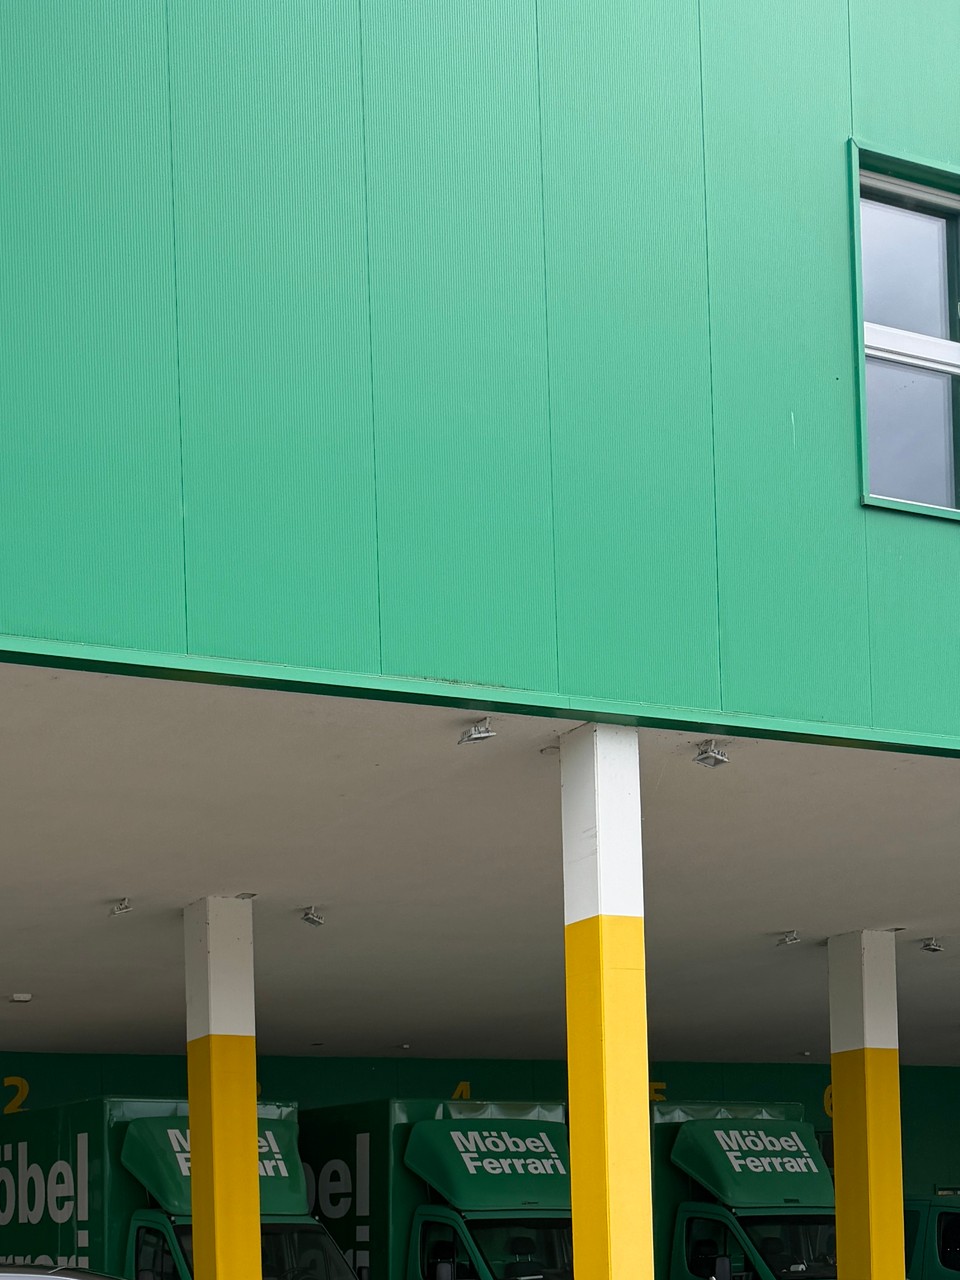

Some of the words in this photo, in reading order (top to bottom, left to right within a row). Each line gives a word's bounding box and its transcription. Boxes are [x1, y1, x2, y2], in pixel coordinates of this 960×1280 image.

[3, 1076, 30, 1114] 2
[450, 1131, 556, 1152] Möbel
[713, 1129, 807, 1152] Möbel
[460, 1152, 567, 1175] Ferrari
[725, 1152, 819, 1173] Ferrari
